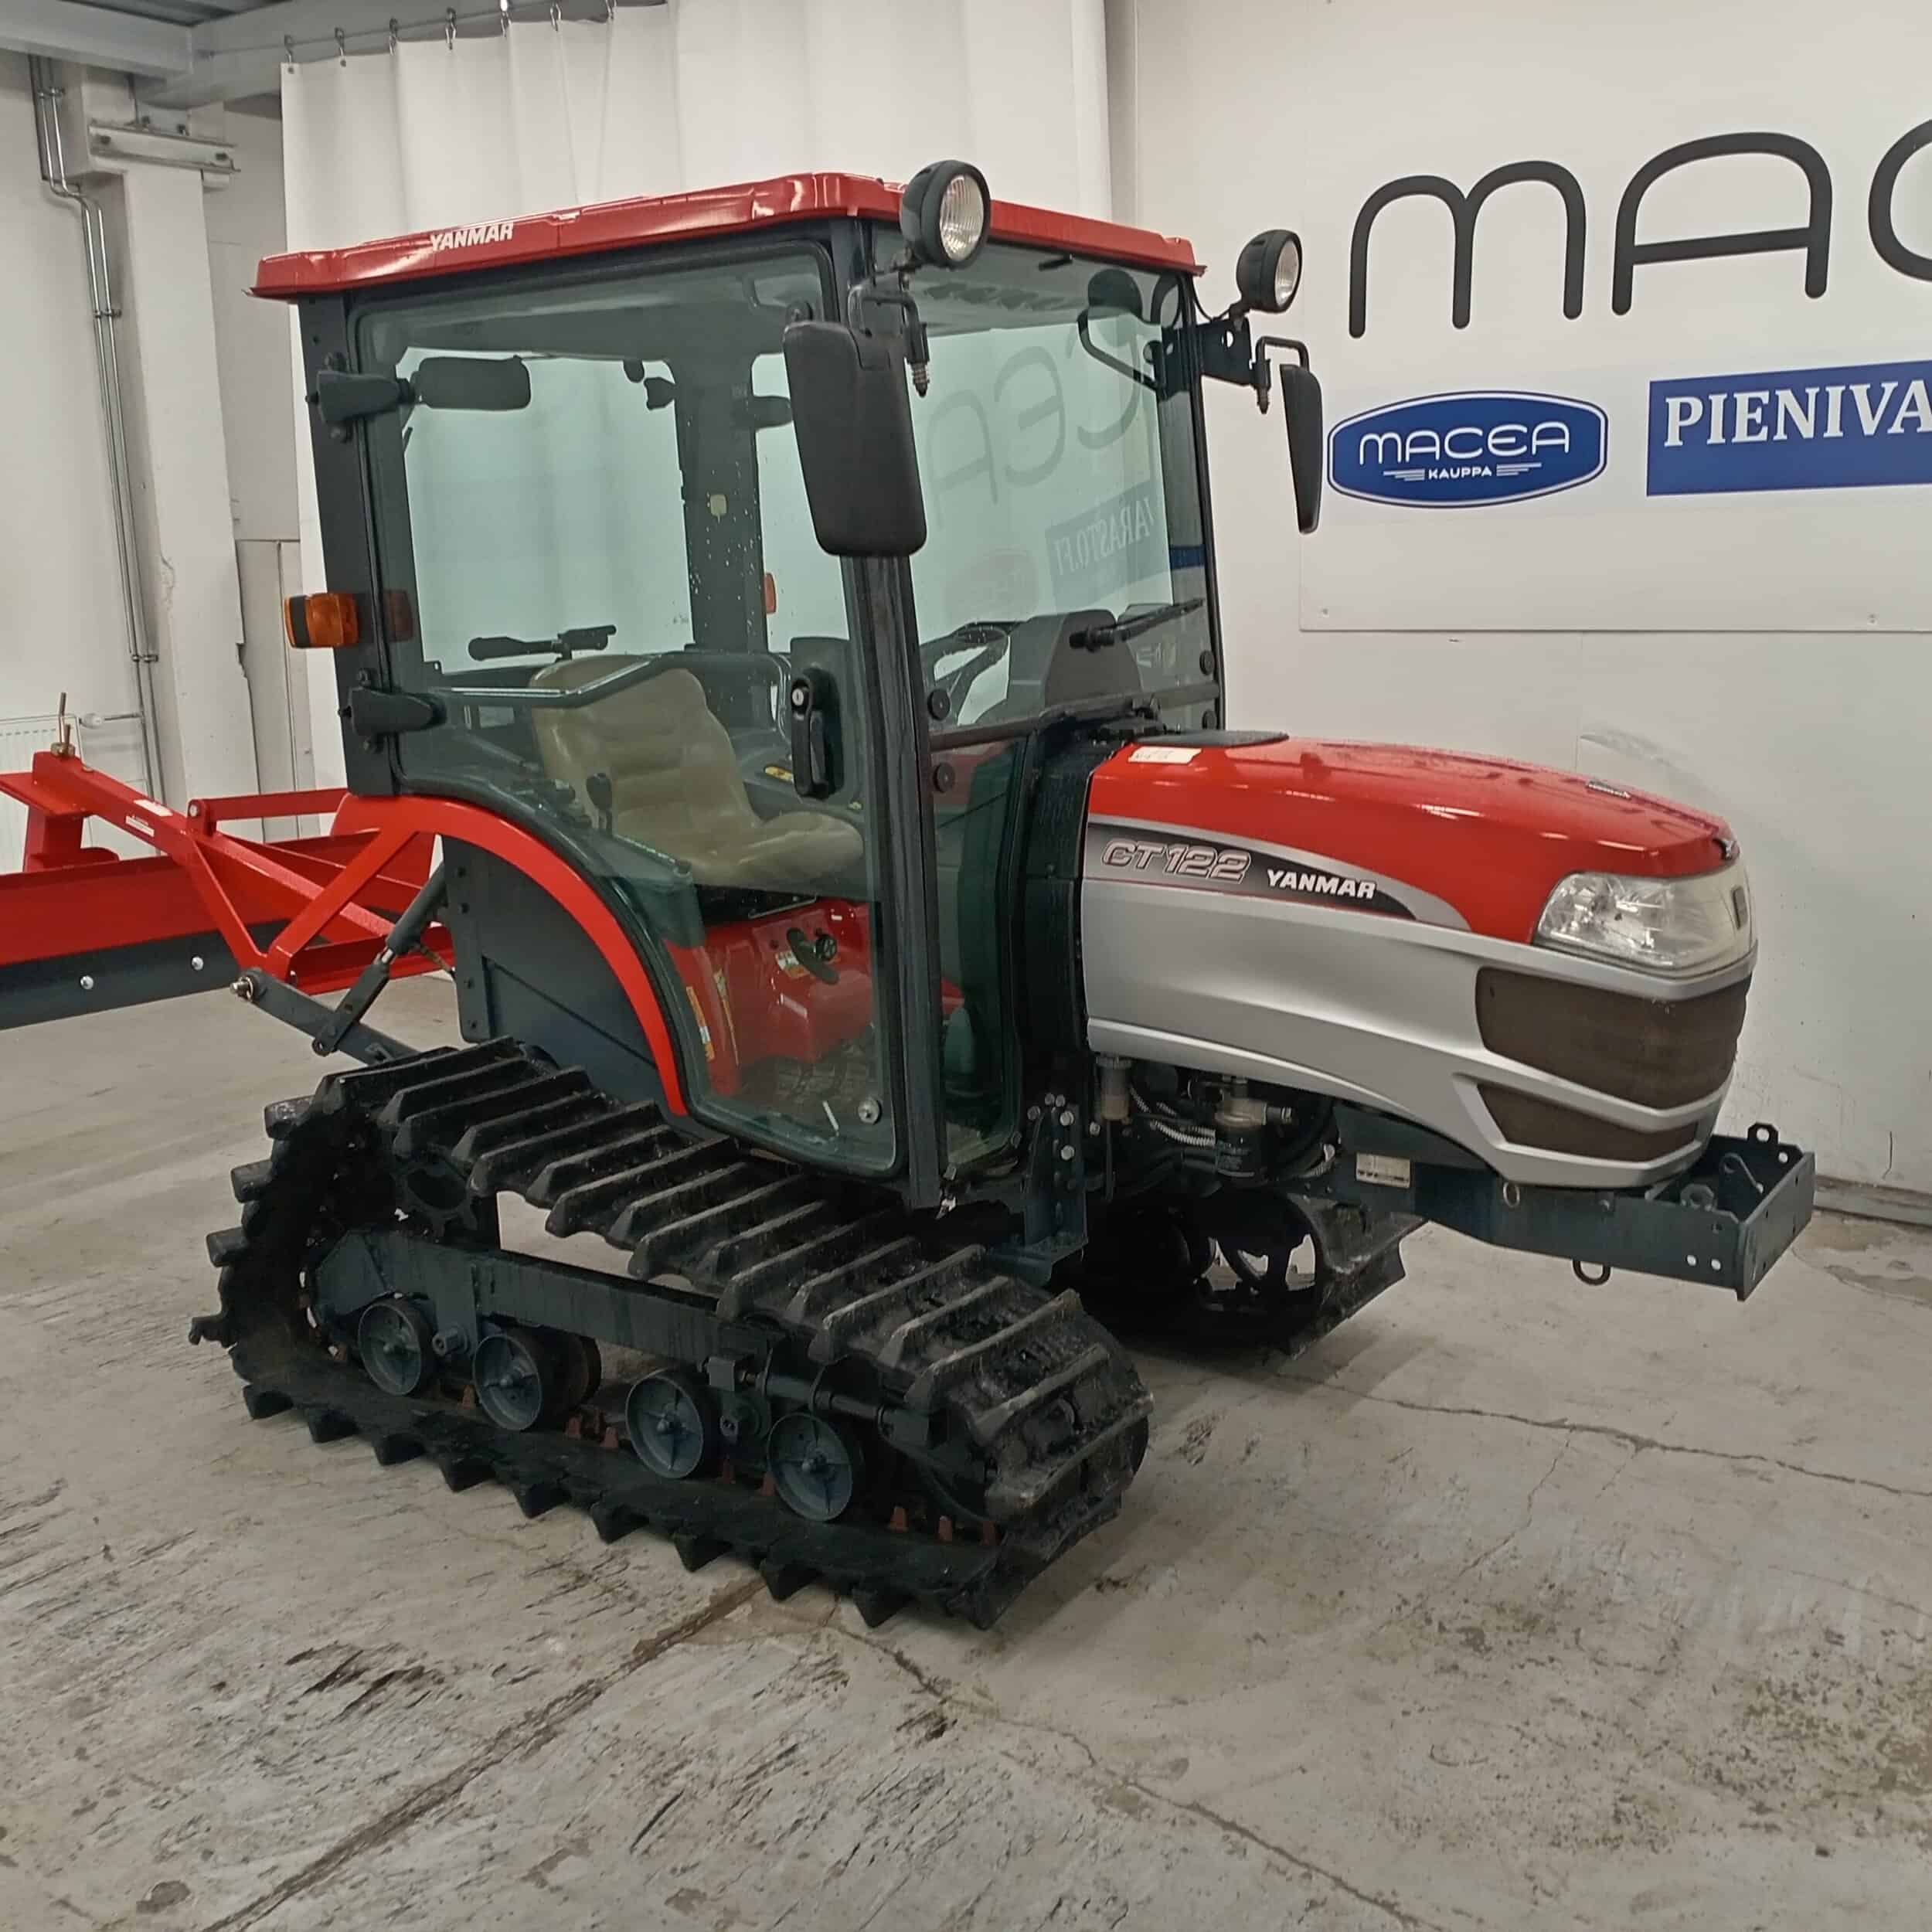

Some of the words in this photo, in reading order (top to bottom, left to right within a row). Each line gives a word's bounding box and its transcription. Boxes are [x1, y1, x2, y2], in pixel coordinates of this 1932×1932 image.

[430, 222, 514, 252] YANMAR
[1349, 116, 1932, 339] MA
[1664, 379, 1932, 447] PIENIVA
[1359, 420, 1570, 466] MACEA
[1428, 466, 1492, 480] KAUPPA
[1101, 838, 1252, 885] CT122
[1267, 869, 1377, 900] YANMAR
